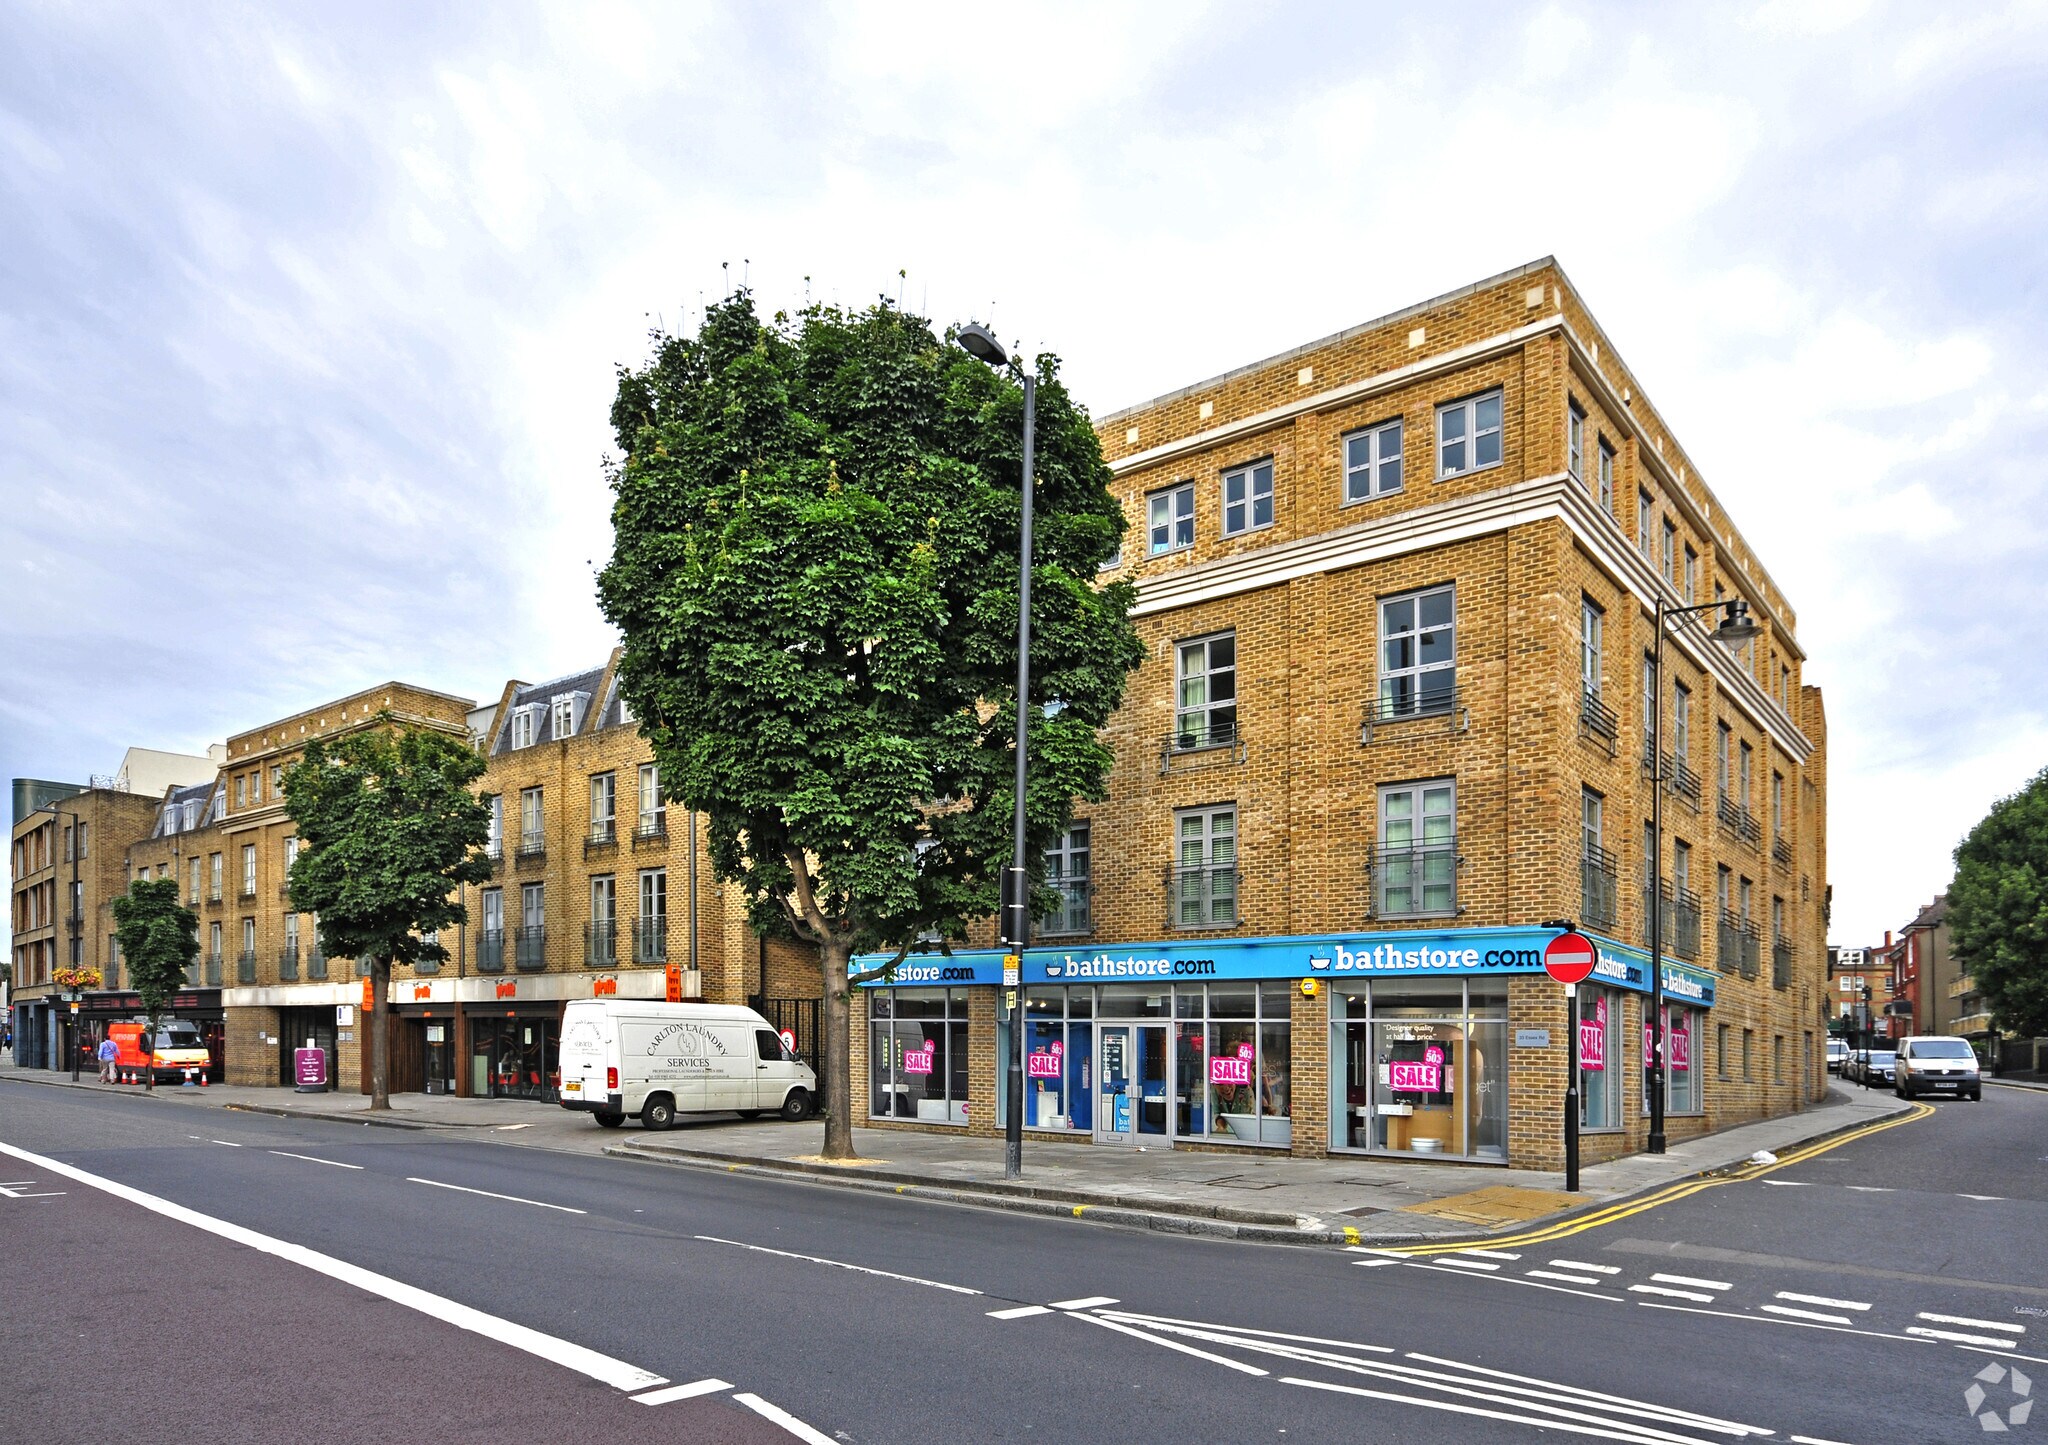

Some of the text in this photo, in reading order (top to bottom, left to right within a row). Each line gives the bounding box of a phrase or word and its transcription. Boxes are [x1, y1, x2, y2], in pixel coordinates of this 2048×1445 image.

[1064, 954, 1216, 977] bathstore.com
[1334, 943, 1543, 970] bathstore.com
[1668, 969, 1714, 1002] bathstore.com
[1414, 1024, 1434, 1033] quality
[646, 1023, 728, 1057] CARLTON LAUNDRY
[784, 1037, 790, 1048] 5
[1580, 1028, 1602, 1061] SALE
[1671, 1033, 1687, 1061] SALE
[667, 1058, 710, 1067] SERVICES
[906, 1054, 930, 1070] SALE
[1031, 1056, 1057, 1073] SALE
[1425, 1052, 1442, 1063] 50%
[1214, 1061, 1246, 1080] SALE
[1395, 1066, 1434, 1086] SALE
